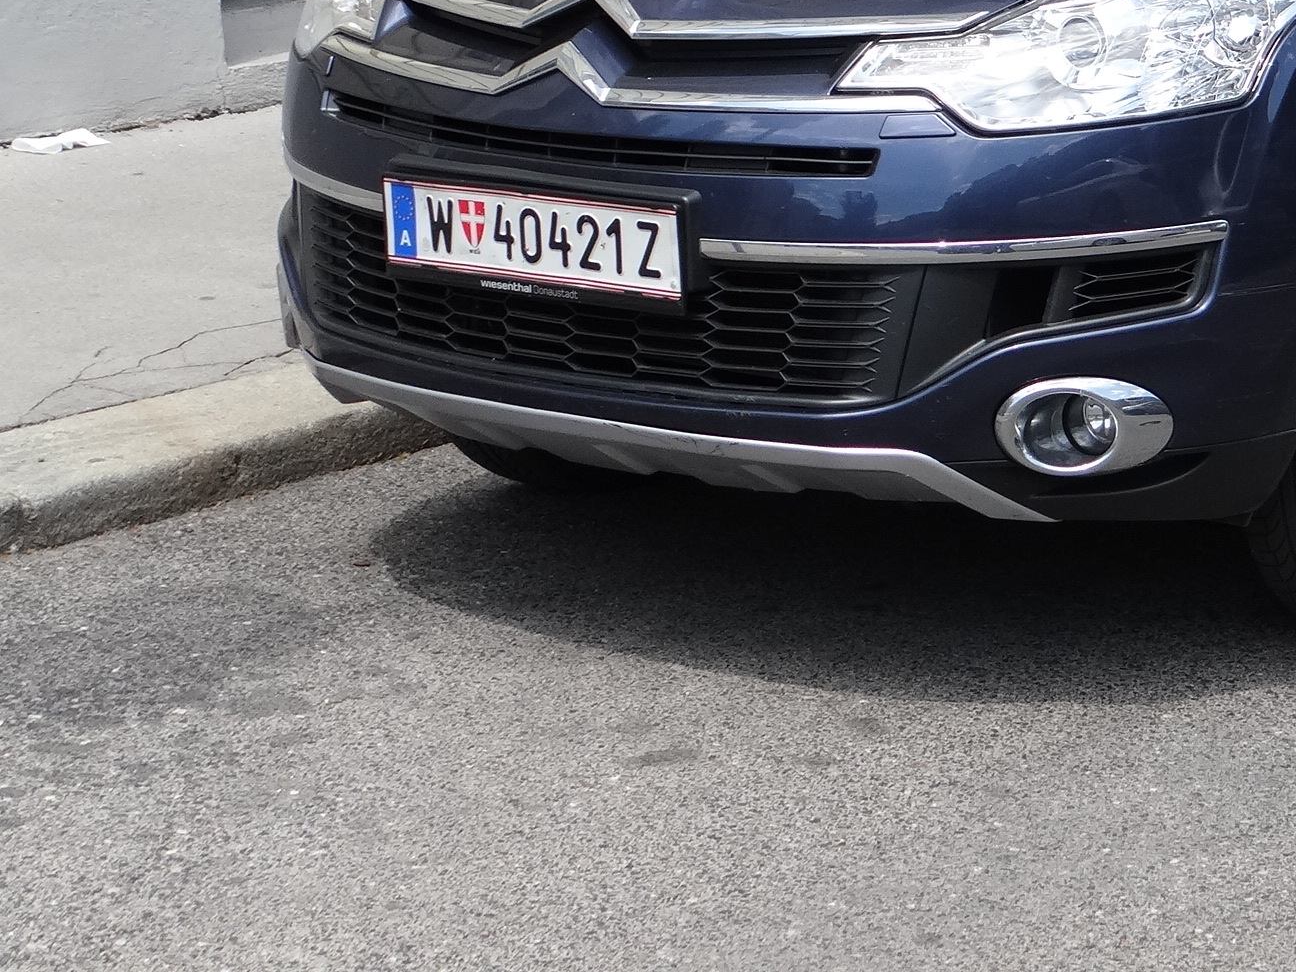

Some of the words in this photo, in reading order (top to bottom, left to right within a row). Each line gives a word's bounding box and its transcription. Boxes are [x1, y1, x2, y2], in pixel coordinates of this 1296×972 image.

[426, 195, 453, 254] W
[399, 229, 412, 247] A
[480, 279, 532, 293] wiesenthal
[532, 284, 579, 300] Donaustadt
